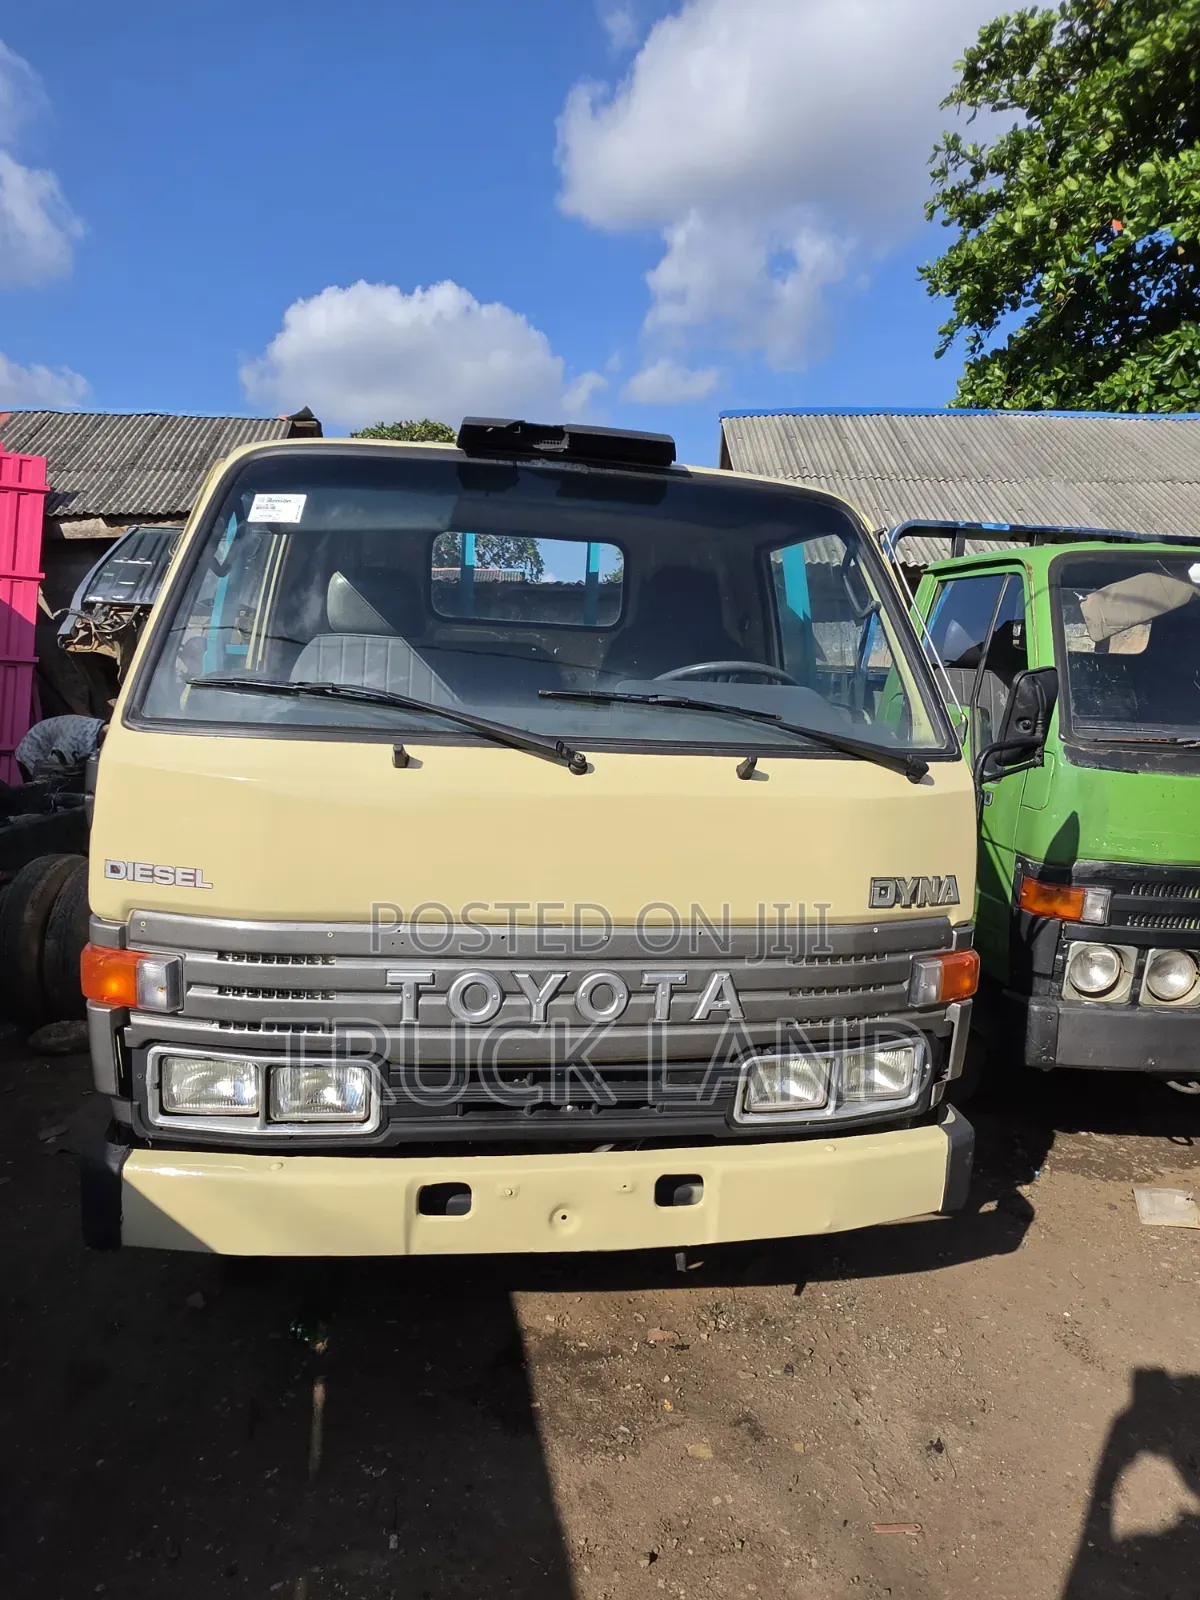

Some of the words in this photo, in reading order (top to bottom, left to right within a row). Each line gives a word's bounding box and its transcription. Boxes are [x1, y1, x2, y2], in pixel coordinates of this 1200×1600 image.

[105, 859, 213, 889] DIESEL
[868, 875, 960, 908] DYNA
[385, 968, 746, 1024] TOYOTA
